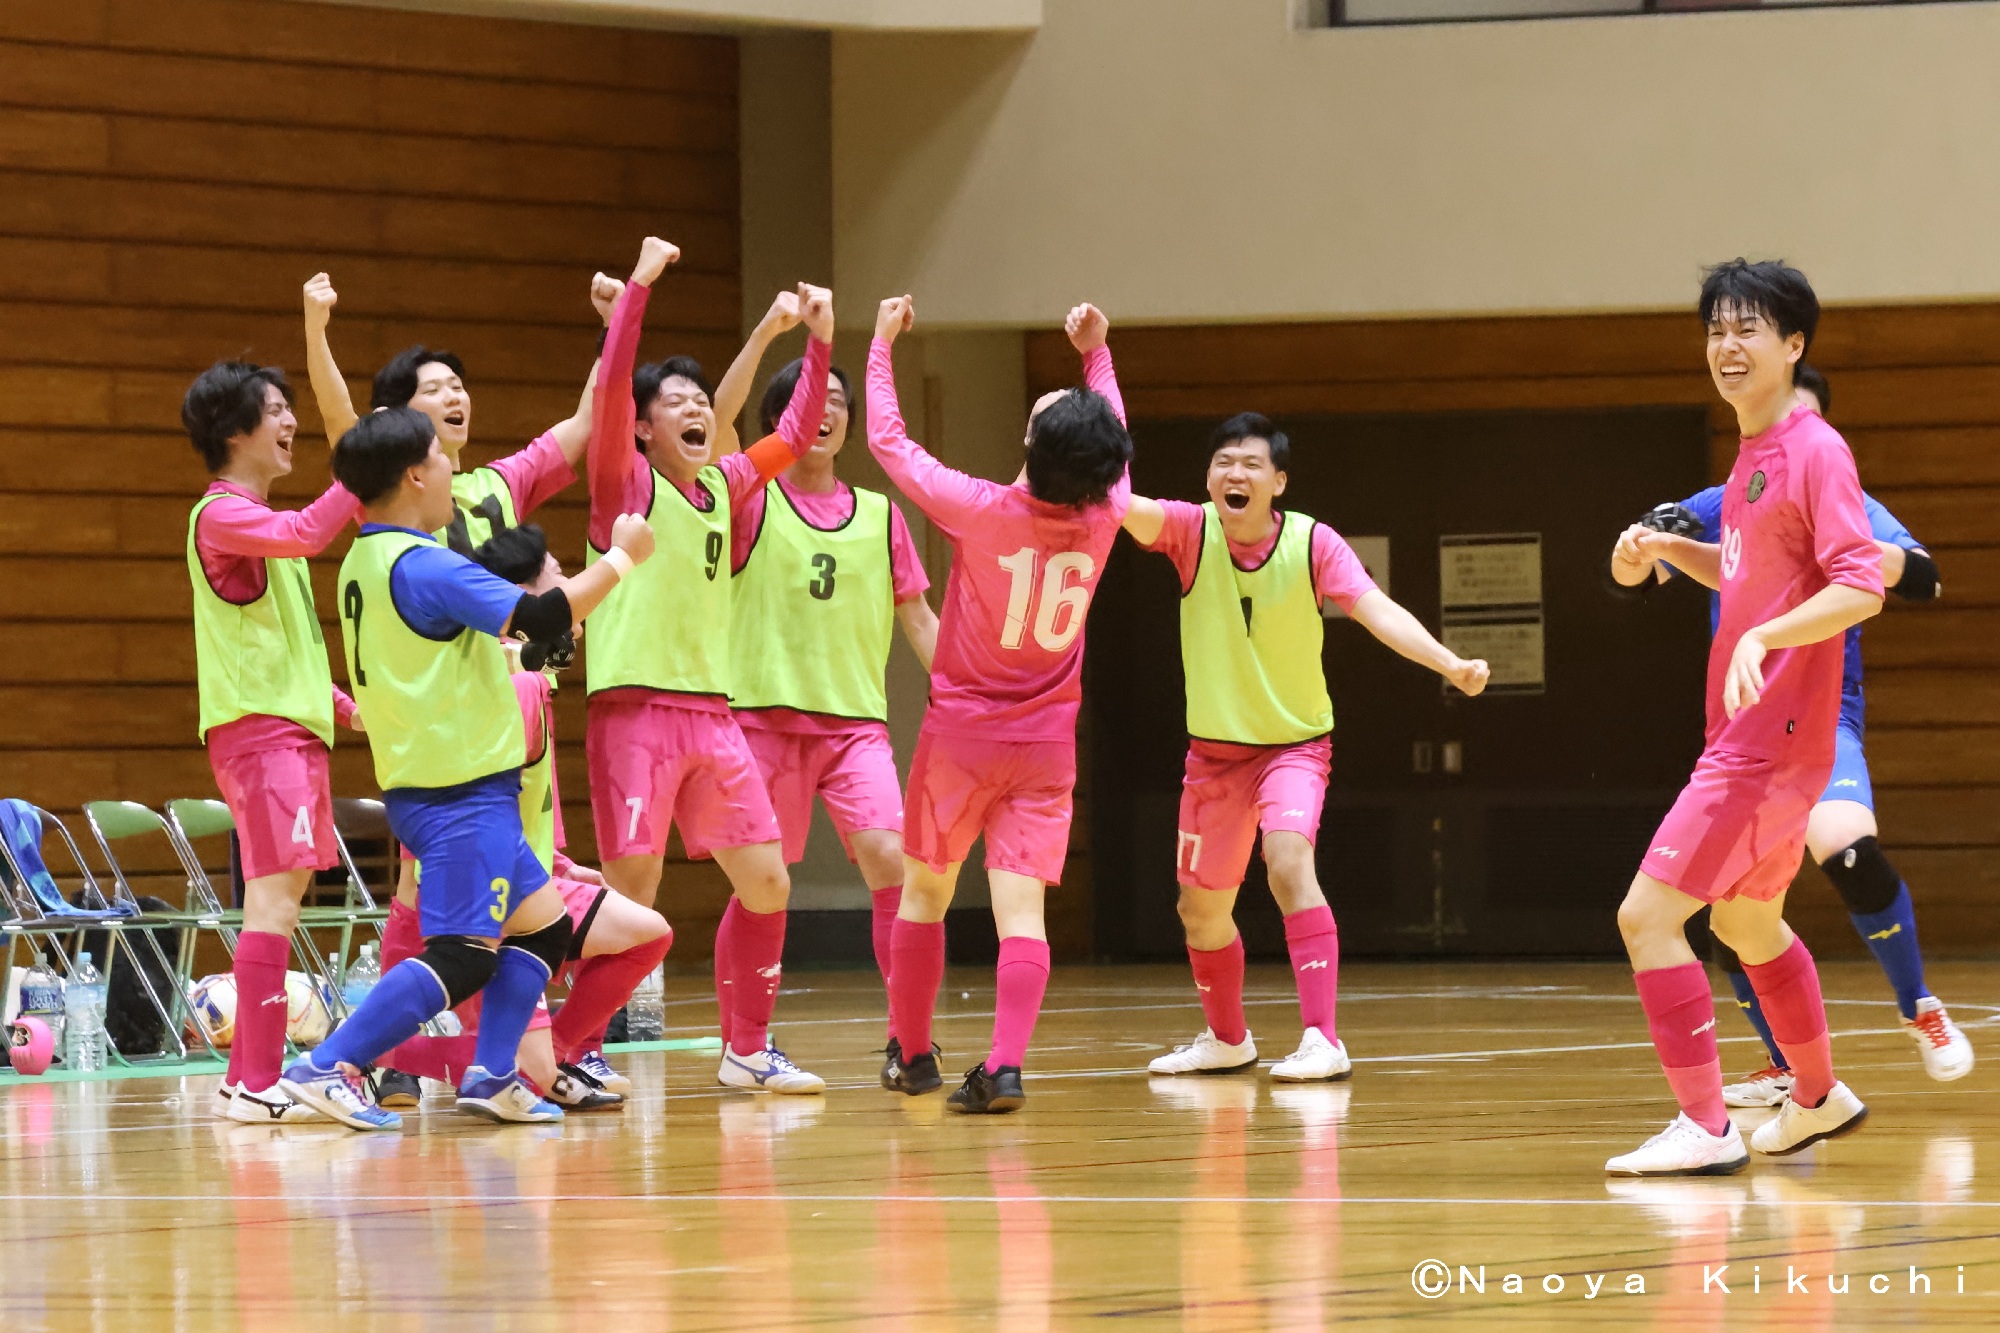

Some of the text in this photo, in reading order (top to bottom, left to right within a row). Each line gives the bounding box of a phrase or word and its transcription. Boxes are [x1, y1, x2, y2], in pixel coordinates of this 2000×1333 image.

[705, 531, 723, 582] 9
[809, 553, 837, 600] 3
[998, 547, 1095, 652] 16
[344, 579, 367, 687] 2
[291, 805, 315, 849] 4
[625, 797, 642, 840] 7
[489, 877, 510, 923] 3
